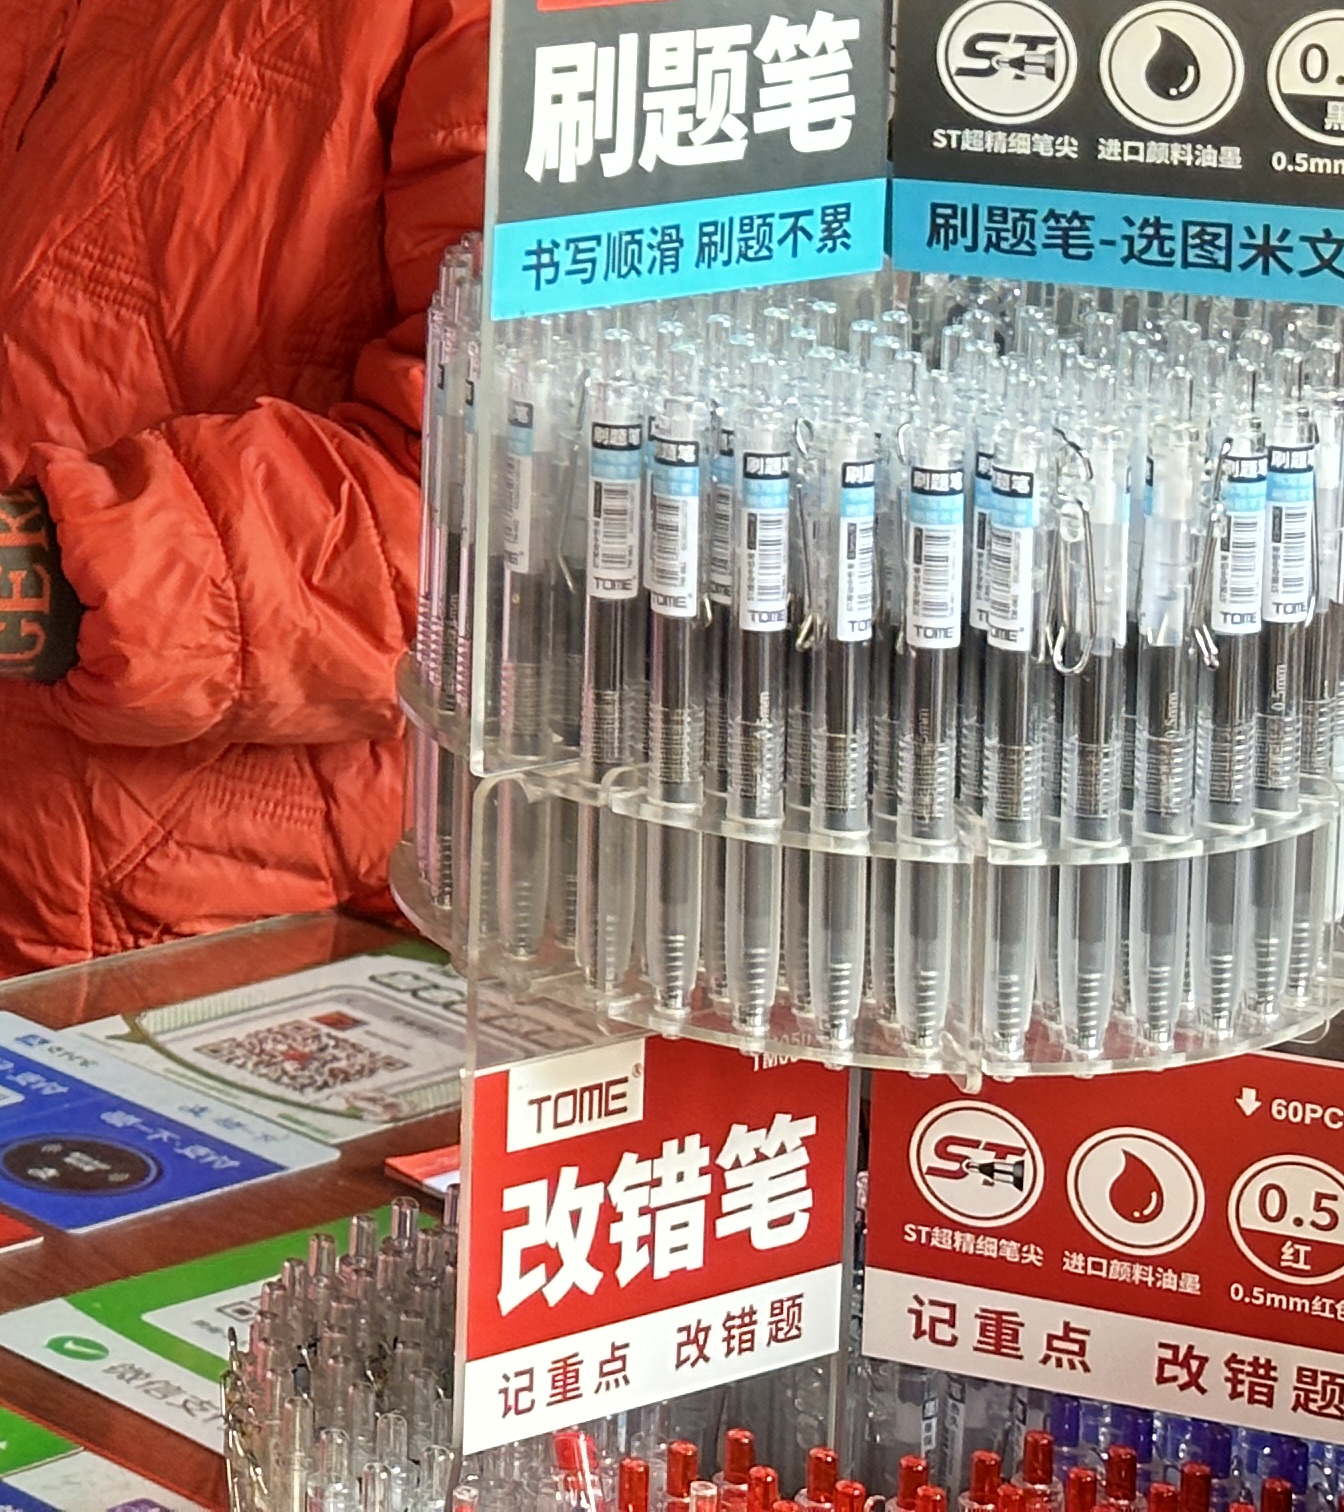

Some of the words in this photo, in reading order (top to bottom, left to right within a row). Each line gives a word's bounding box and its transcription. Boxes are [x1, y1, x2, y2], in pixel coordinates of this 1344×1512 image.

[525, 9, 861, 185] 刷题笔
[932, 127, 1080, 161] ST超精细笔尖
[1096, 136, 1243, 170] 进口颜料油墨
[521, 226, 686, 291] 书写顺滑
[693, 202, 855, 267] 刷题不累
[593, 575, 633, 590] TOME
[749, 609, 785, 624] TOME
[913, 624, 954, 639] TOME
[1220, 611, 1257, 625] TOME
[527, 1074, 631, 1133] TOME
[495, 1111, 818, 1317] 改错笔
[1256, 1182, 1340, 1232] 0.5
[903, 1223, 1045, 1266] ST超精细笔尖
[1279, 1239, 1313, 1272] 红
[1061, 1250, 1202, 1296] 进口颜料油墨
[497, 1341, 632, 1419] 记重点
[673, 1292, 806, 1373] 改错题
[906, 1294, 1093, 1374] 记重点
[1155, 1340, 1344, 1419] 改错题
